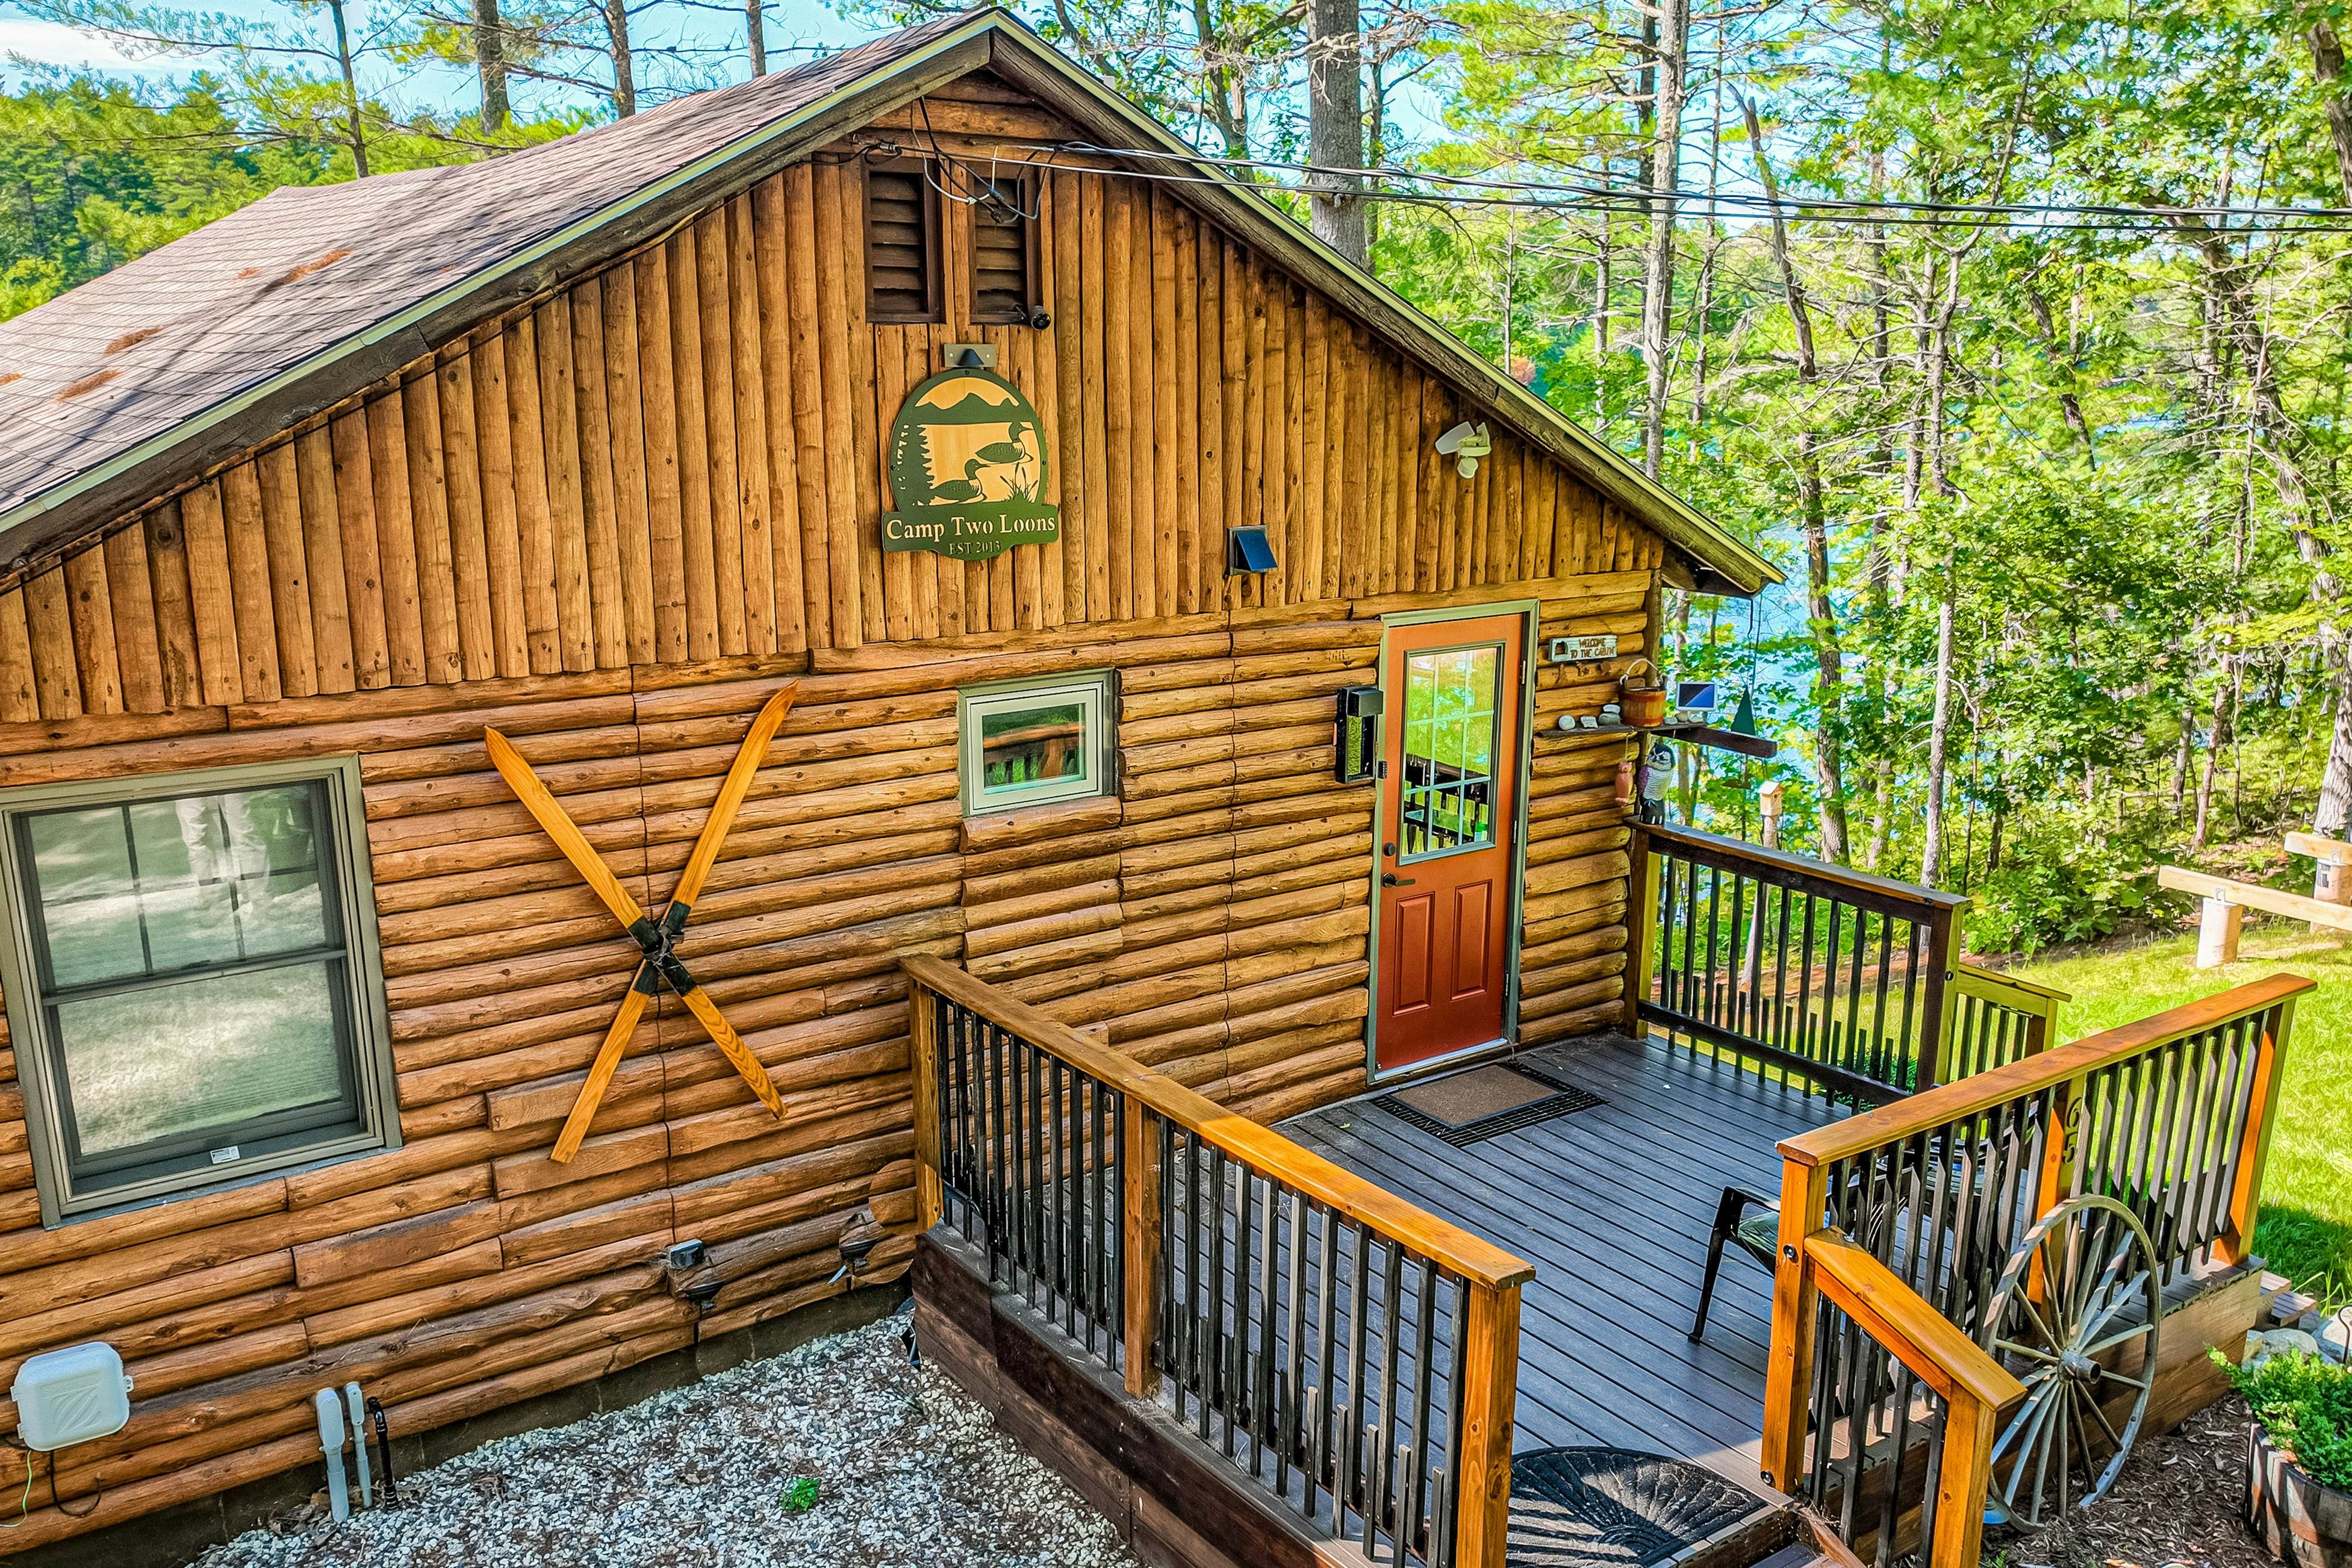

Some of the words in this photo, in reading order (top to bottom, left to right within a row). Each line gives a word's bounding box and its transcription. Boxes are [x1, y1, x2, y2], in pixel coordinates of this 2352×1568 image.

[886, 519, 945, 542] Camp
[951, 516, 993, 535] Two
[999, 514, 1056, 533] Loons
[949, 542, 971, 555] EST
[975, 541, 1000, 553] 2013
[1578, 638, 1606, 648] WELCOME
[1570, 649, 1578, 659] TO
[1581, 649, 1592, 658] THE
[1594, 646, 1615, 656] CABIN
